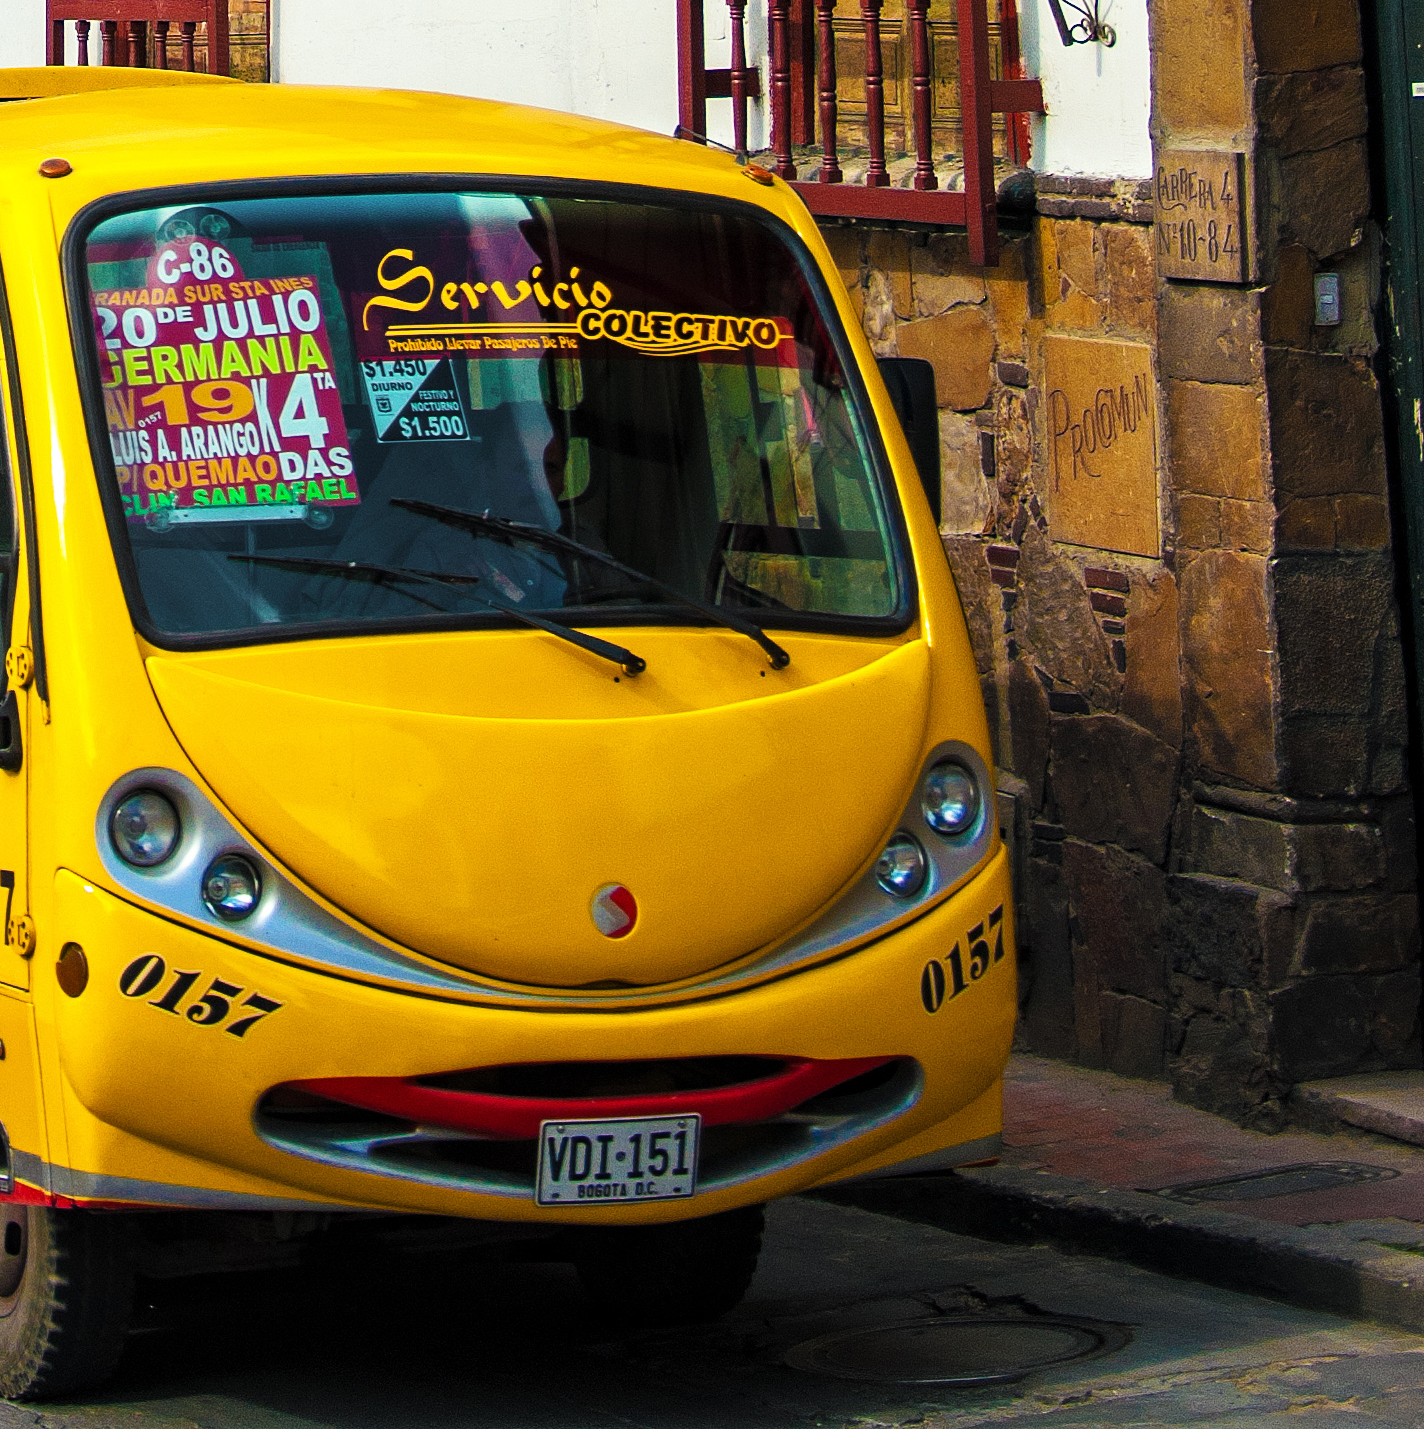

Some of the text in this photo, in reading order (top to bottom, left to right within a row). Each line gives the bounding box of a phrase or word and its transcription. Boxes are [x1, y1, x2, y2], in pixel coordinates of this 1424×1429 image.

[1157, 166, 1233, 211] CARRERA 4
[157, 242, 235, 284] C-86
[94, 277, 314, 306] RANADA SUR STA INES
[362, 248, 613, 331] Servicio
[96, 289, 321, 350] 20 DE JULIO
[576, 308, 781, 349] COLECTIVO
[103, 333, 328, 388] GERMANIA
[387, 335, 579, 353] Prohibido Llevar Pasajeros De Pie
[363, 357, 428, 380] $1.450
[370, 382, 414, 392] DIURNO
[419, 390, 455, 401] FESTIVO Y
[104, 388, 135, 430] AV
[141, 380, 255, 426] 19
[251, 378, 281, 453] K
[138, 411, 162, 428] 0157
[410, 401, 460, 413] NOCTURNO
[110, 421, 260, 466] LUIS A. ARANGO
[398, 415, 464, 440] $1.500
[193, 486, 248, 507] SAN
[254, 478, 357, 506] RAFAEL
[920, 903, 1005, 1014] 0157
[119, 954, 286, 1039] 0157
[577, 1181, 658, 1199] BOGOTA D.C.
